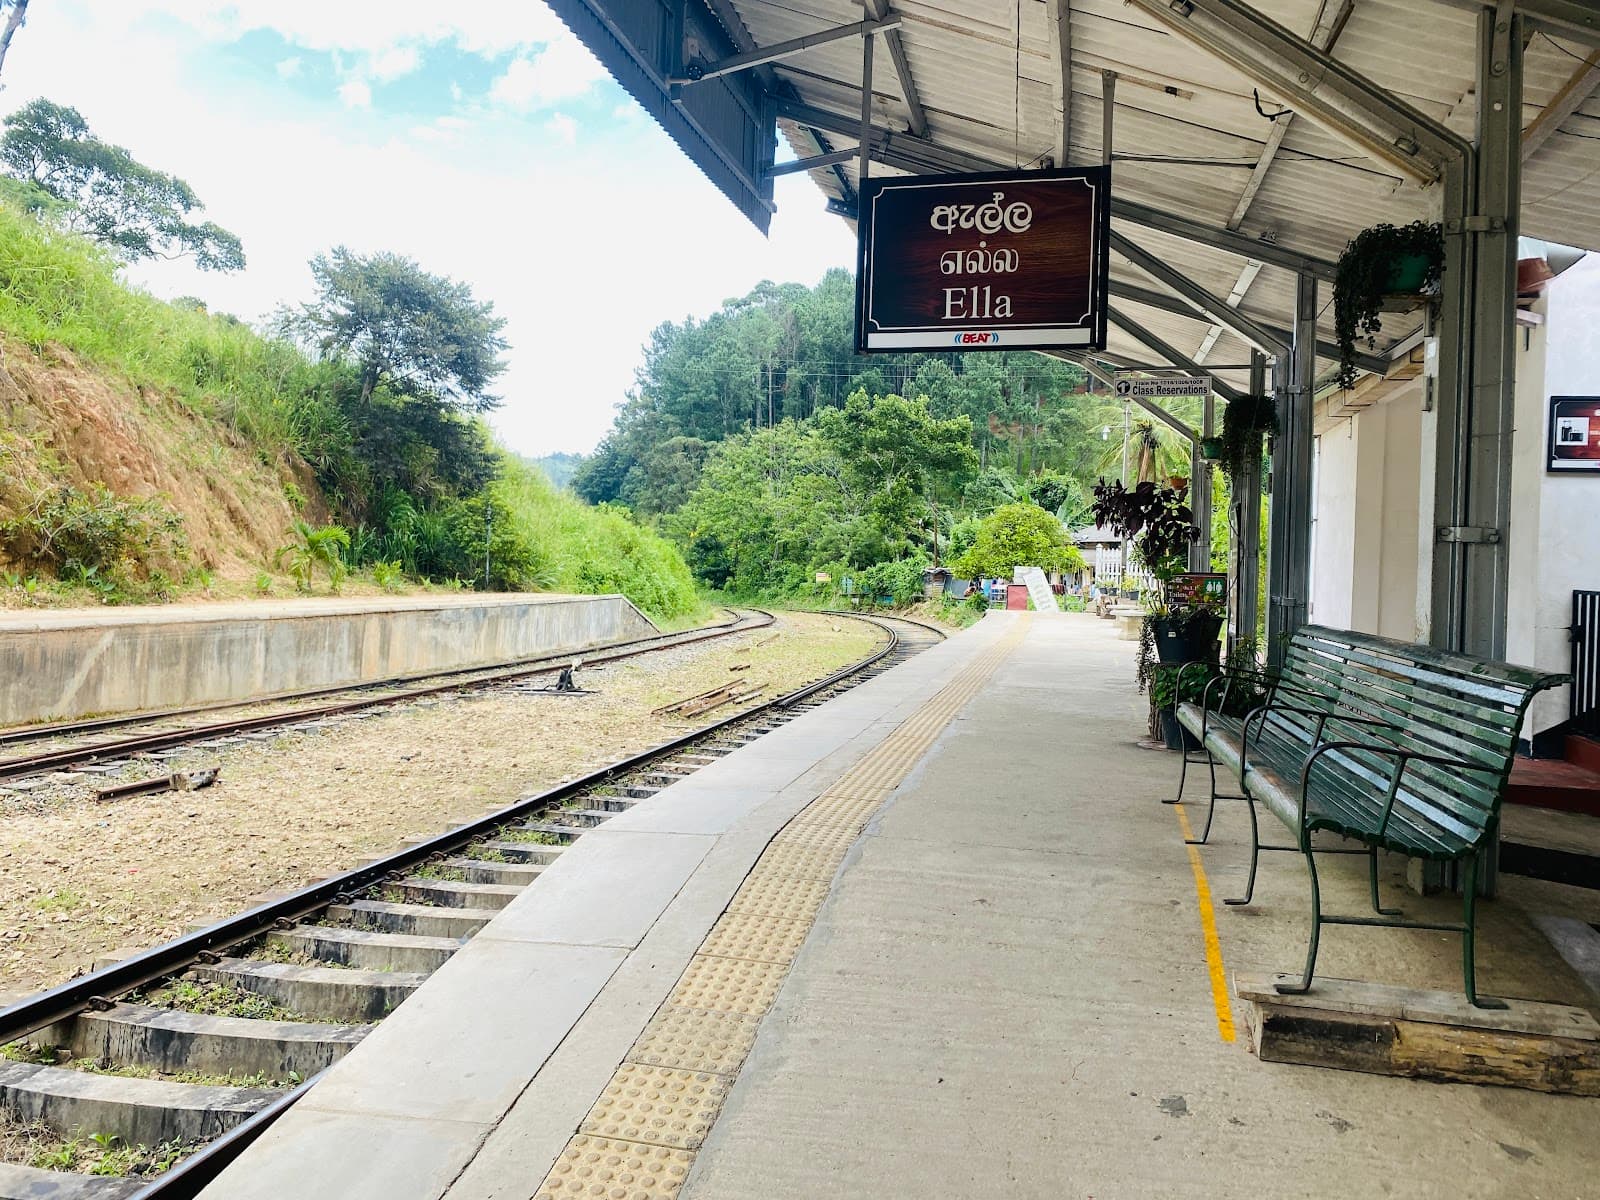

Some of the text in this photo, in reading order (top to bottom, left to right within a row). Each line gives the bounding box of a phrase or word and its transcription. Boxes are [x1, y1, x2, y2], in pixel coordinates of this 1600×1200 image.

[930, 192, 1033, 235] ඇල්ල
[940, 241, 1019, 275] எல்ல
[941, 285, 1014, 320] Ella
[962, 333, 991, 343] BEAT
[1132, 385, 1208, 395] Class Reservations
